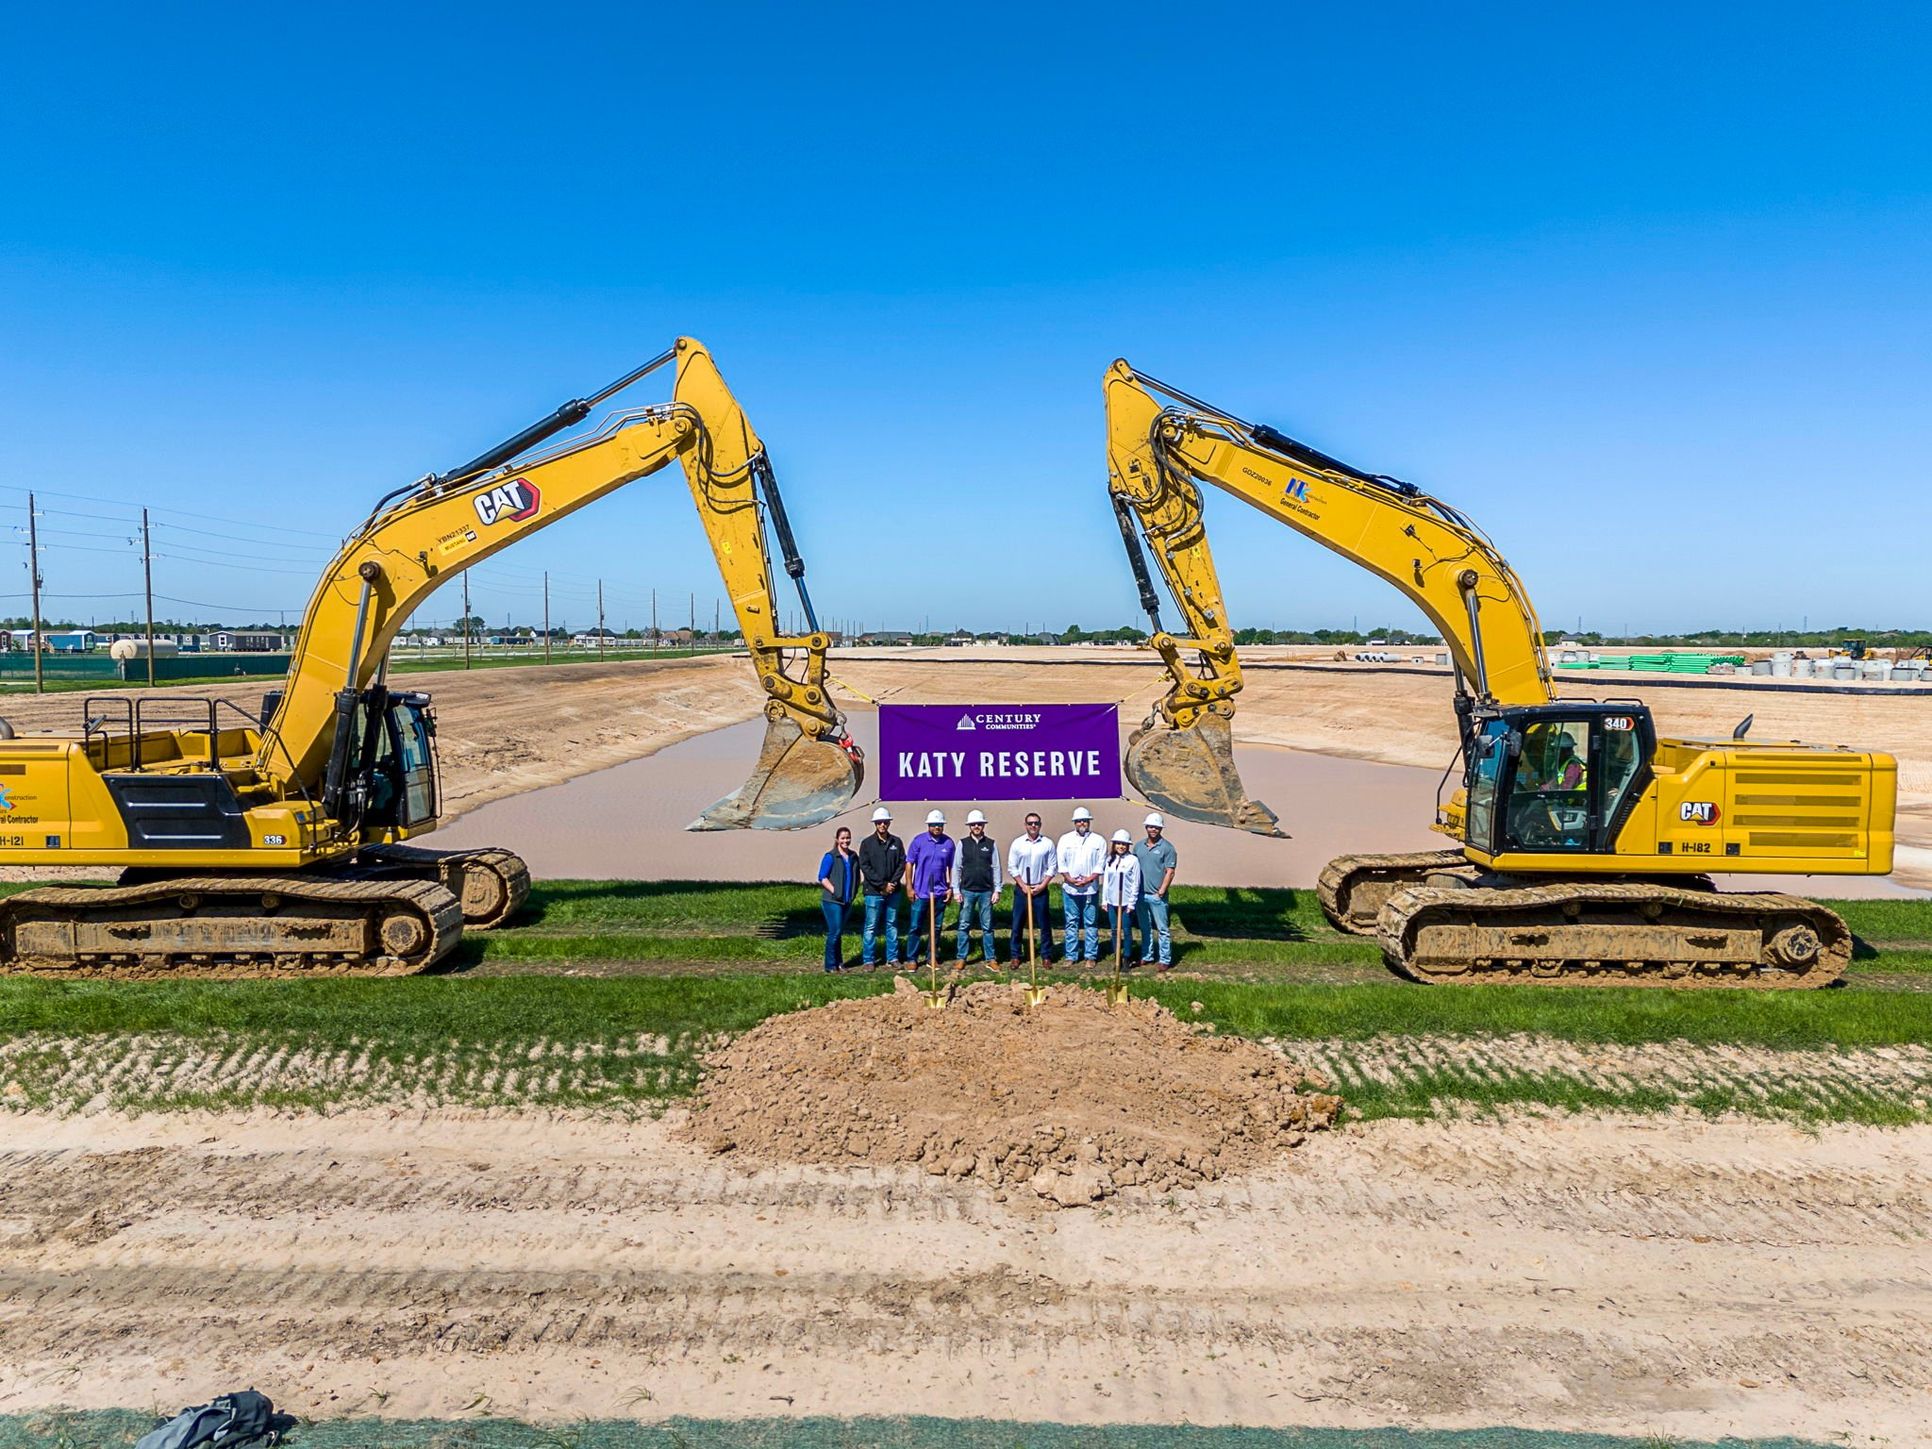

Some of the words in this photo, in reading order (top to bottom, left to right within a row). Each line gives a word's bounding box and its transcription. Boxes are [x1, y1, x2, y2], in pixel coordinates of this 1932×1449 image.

[474, 480, 525, 524] CAT
[1280, 498, 1298, 511] General
[1297, 506, 1320, 520] Contractor
[976, 713, 1041, 723] CENTURY
[1604, 717, 1628, 730] 340
[899, 752, 966, 777] KATY
[980, 750, 1100, 777] RESERVE
[1681, 802, 1712, 820] CAT
[7, 815, 39, 824] Contractor
[0, 836, 24, 846] H-121
[264, 835, 282, 845] 336
[1681, 842, 1711, 853] H-182
